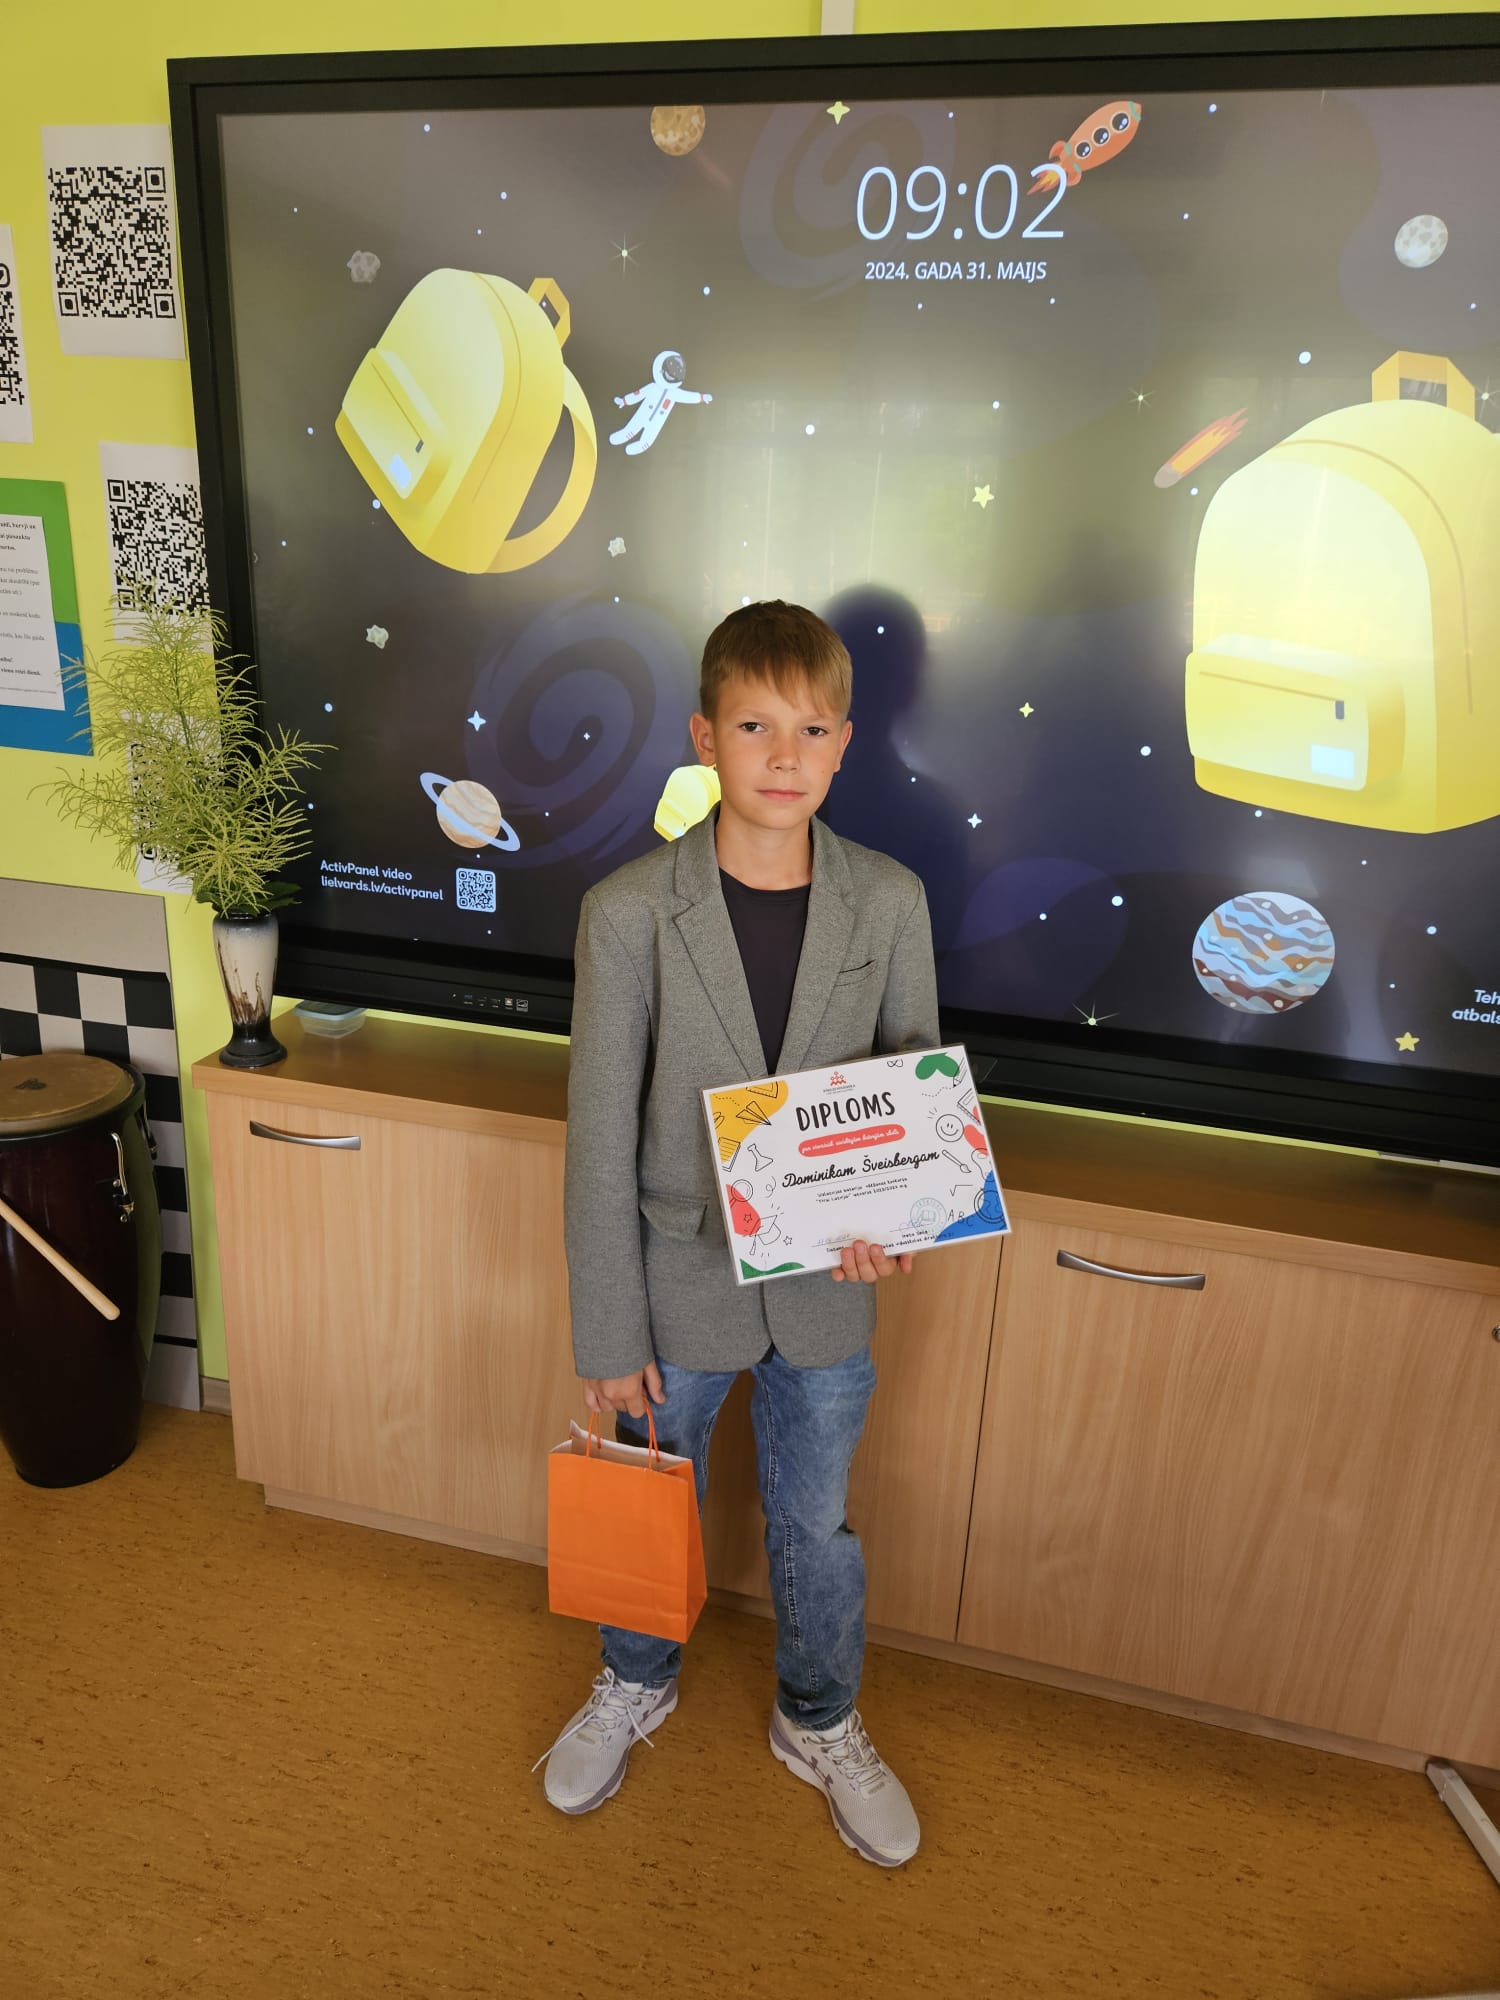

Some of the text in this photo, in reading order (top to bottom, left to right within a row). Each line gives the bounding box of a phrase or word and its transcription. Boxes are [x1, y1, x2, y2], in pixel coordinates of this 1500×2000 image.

[856, 163, 1067, 240] 09:02
[864, 261, 1047, 283] 2024. GADA 31. MAIJS
[320, 859, 413, 881] ActivPanel video
[321, 875, 444, 901] lielvards.lv/activpanel
[795, 1091, 896, 1132] DIPLOMS
[782, 1150, 940, 1188] Dominikam Šveisbergam
